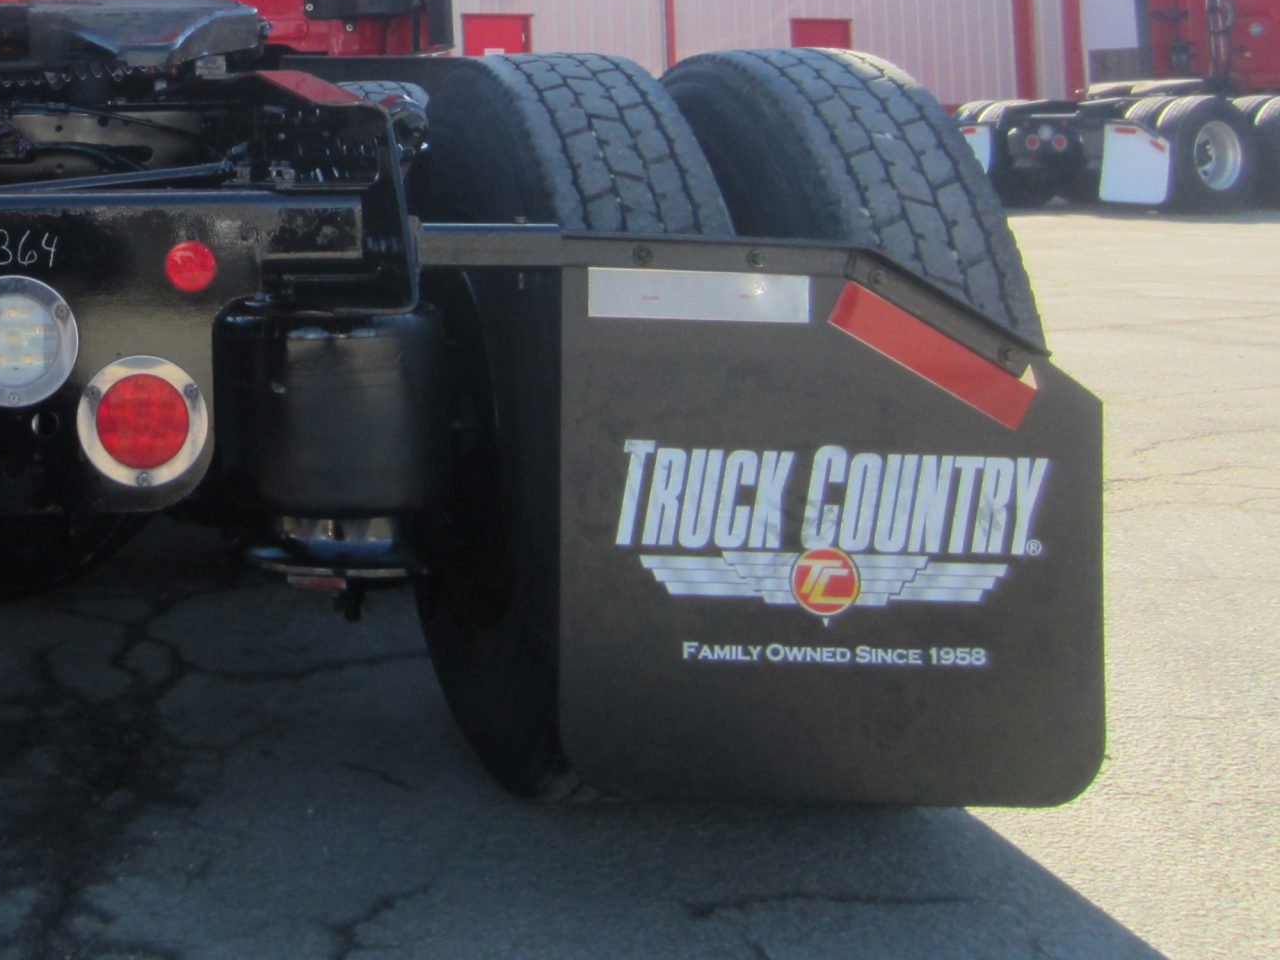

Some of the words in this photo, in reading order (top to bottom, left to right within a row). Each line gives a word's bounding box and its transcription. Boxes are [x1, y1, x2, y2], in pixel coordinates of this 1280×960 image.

[615, 439, 795, 549] TRUCK
[682, 641, 762, 660] FAMILY
[766, 643, 850, 663] OWNED
[855, 645, 922, 664] SINCE
[929, 647, 987, 665] 1958
